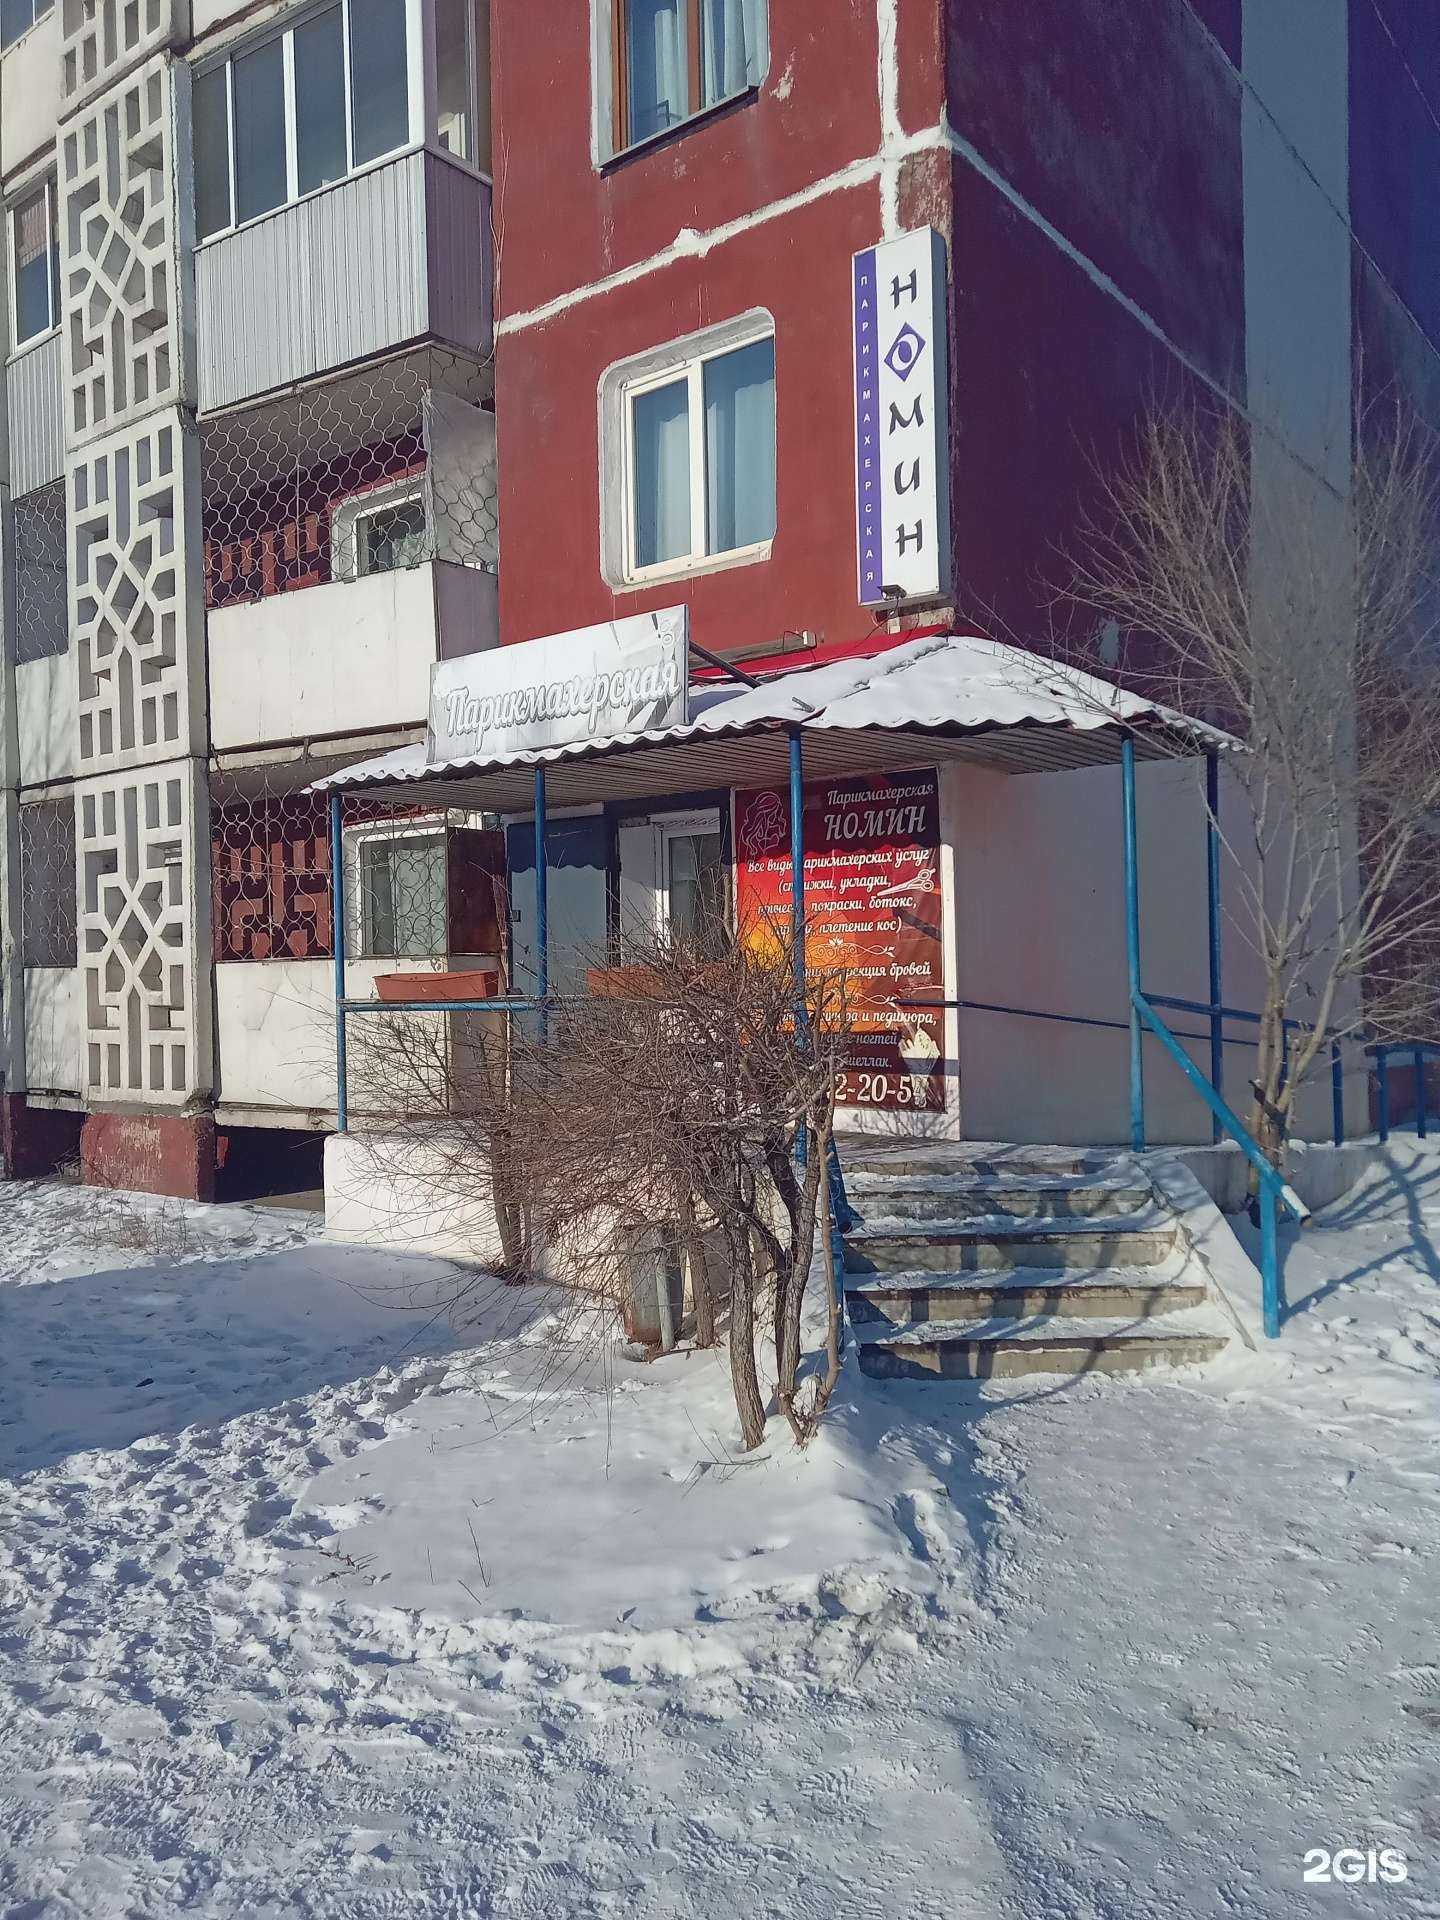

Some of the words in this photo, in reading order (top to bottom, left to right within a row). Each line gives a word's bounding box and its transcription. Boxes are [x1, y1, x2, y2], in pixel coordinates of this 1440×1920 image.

[884, 267, 926, 558] НОМИН
[860, 275, 874, 583] ПАРИКМАХЕРСКАЯ
[446, 660, 681, 754] Парикмахерская
[827, 783, 935, 810] Парикмахерская
[823, 806, 927, 841] НОМИН
[747, 859, 765, 873] Все
[803, 850, 893, 874] арикмахерских
[895, 848, 930, 869] услуг
[839, 876, 892, 895] укладки,
[810, 898, 866, 917] покраски,
[869, 895, 917, 910] ботокс,
[819, 919, 876, 932] плетение
[877, 915, 902, 932] кос)
[826, 965, 886, 981] корекция
[890, 960, 931, 981] бровей
[861, 1012, 870, 1022] и
[872, 1010, 937, 1028] педикюра,
